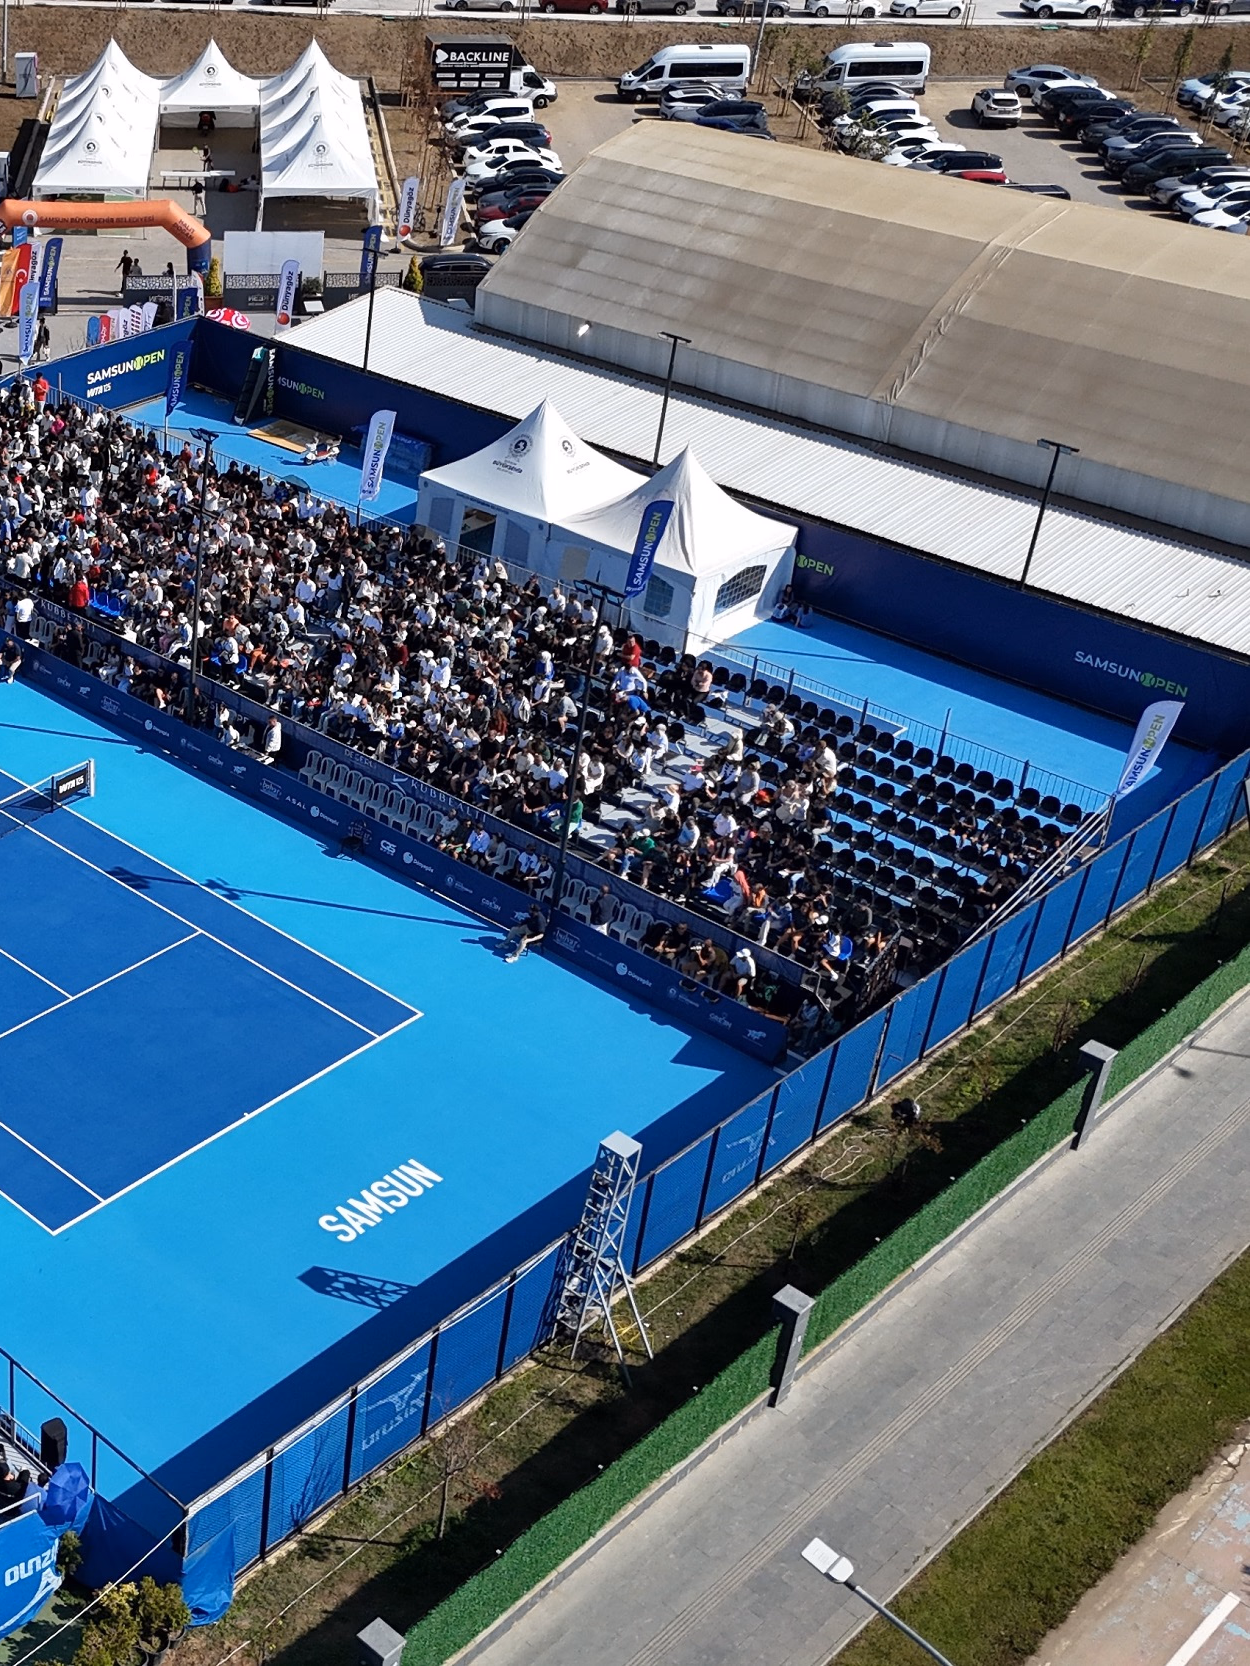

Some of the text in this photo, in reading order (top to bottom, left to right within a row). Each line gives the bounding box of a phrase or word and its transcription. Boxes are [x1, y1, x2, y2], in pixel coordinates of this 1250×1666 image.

[450, 52, 510, 62] BACKLINE
[403, 187, 415, 224] Dünyagöz
[282, 270, 293, 311] Dünyagöz
[285, 794, 307, 810] ASAL
[318, 1158, 444, 1244] SAMSUN
